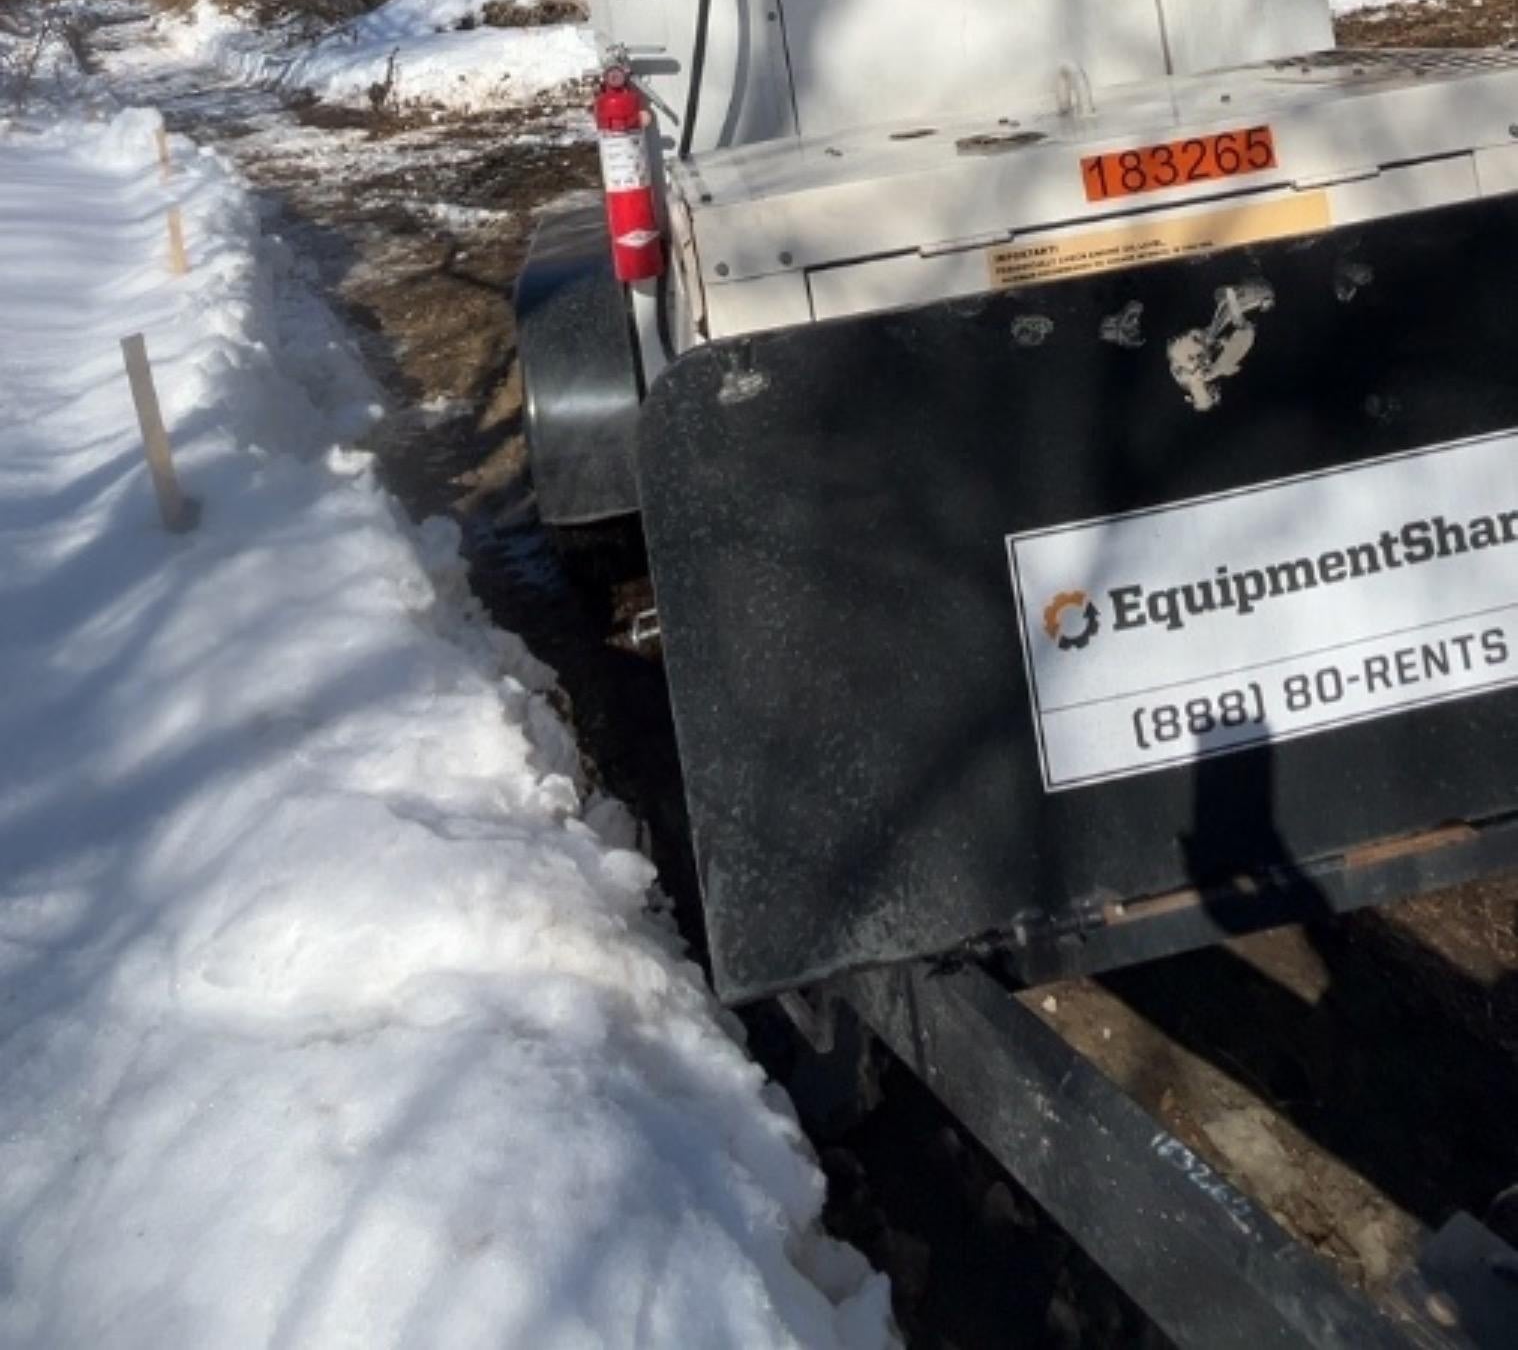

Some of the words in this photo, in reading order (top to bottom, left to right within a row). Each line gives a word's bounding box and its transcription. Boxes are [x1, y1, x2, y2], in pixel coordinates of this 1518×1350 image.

[1088, 125, 1274, 197] 183265
[1132, 682, 1266, 748] (888)
[1283, 628, 1508, 712] 80-RENTS
